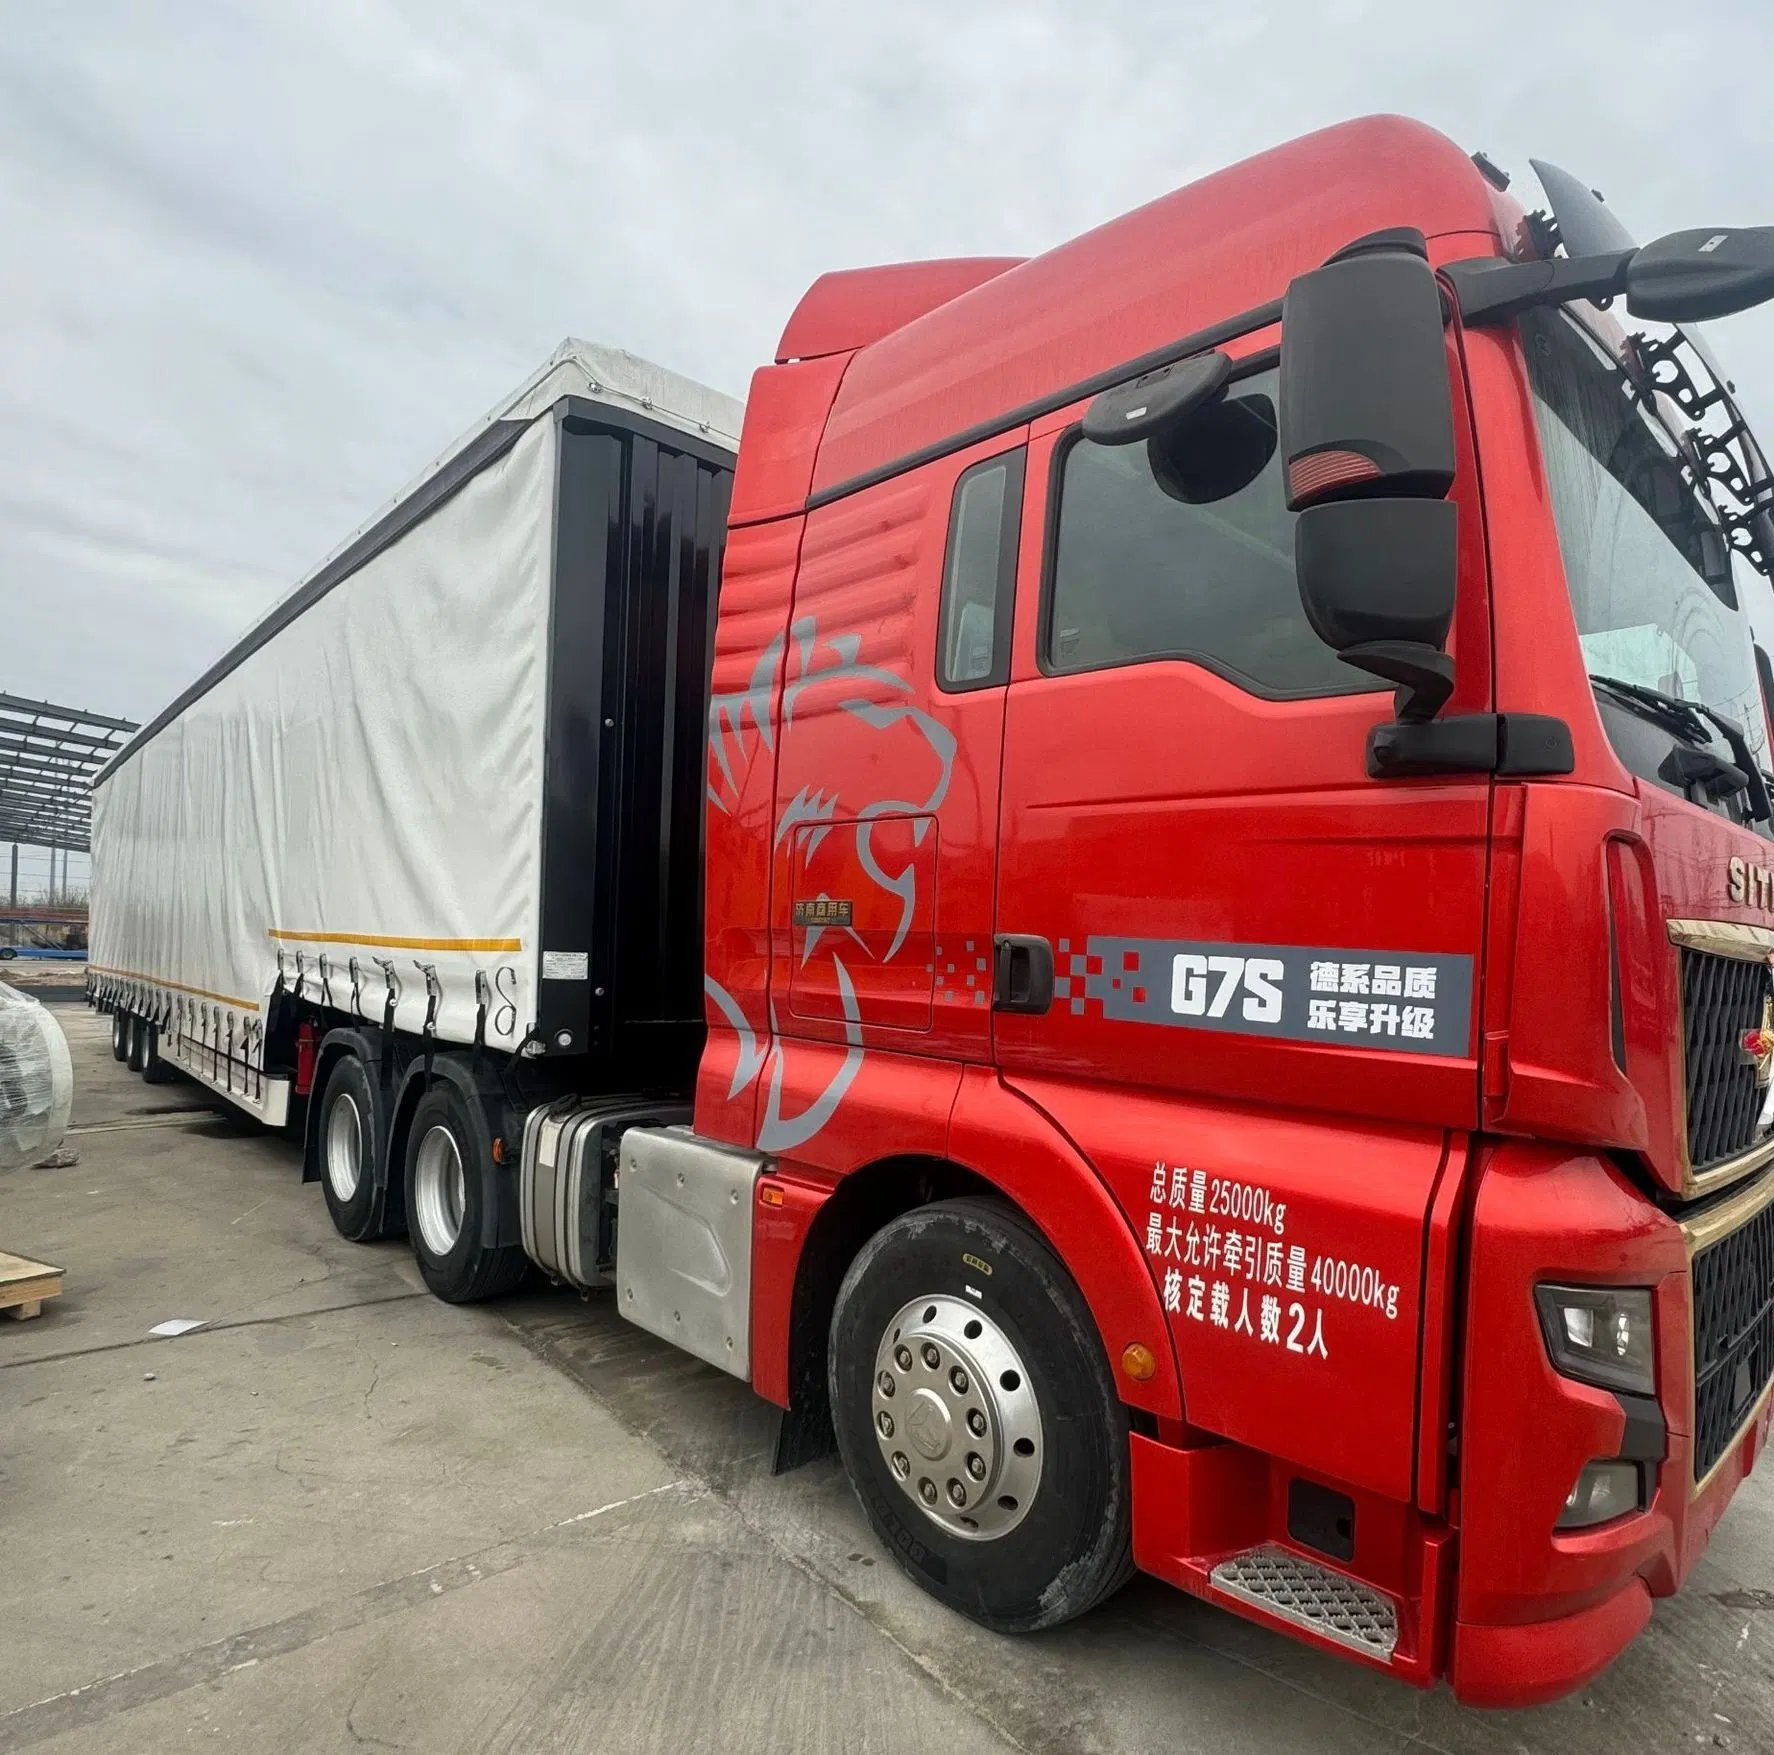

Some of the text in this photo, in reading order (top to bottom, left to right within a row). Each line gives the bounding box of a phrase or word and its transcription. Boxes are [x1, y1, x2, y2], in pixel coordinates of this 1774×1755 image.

[1727, 855, 1774, 913] SIT
[1170, 953, 1285, 1024] G7S
[1309, 960, 1438, 1000] 德系品质
[1307, 1000, 1435, 1040] 乐享升级
